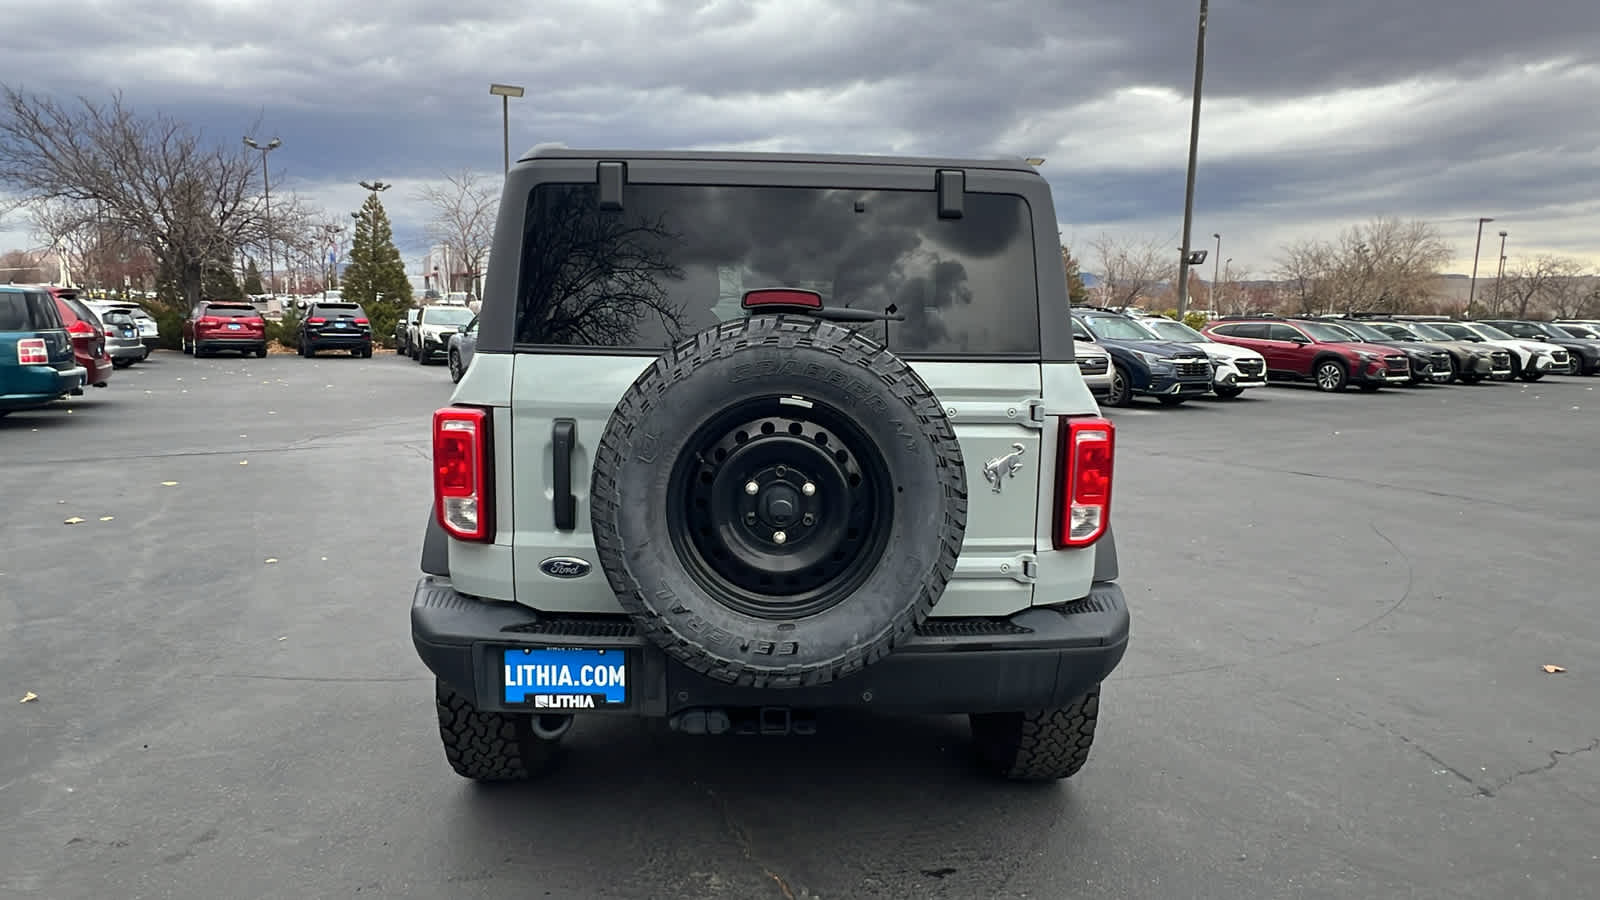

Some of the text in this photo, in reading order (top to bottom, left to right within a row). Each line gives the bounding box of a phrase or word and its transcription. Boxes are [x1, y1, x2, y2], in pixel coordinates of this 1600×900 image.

[550, 561, 580, 574] Ford
[504, 664, 626, 687] LITHIA.COM
[548, 694, 595, 708] LITHIA
